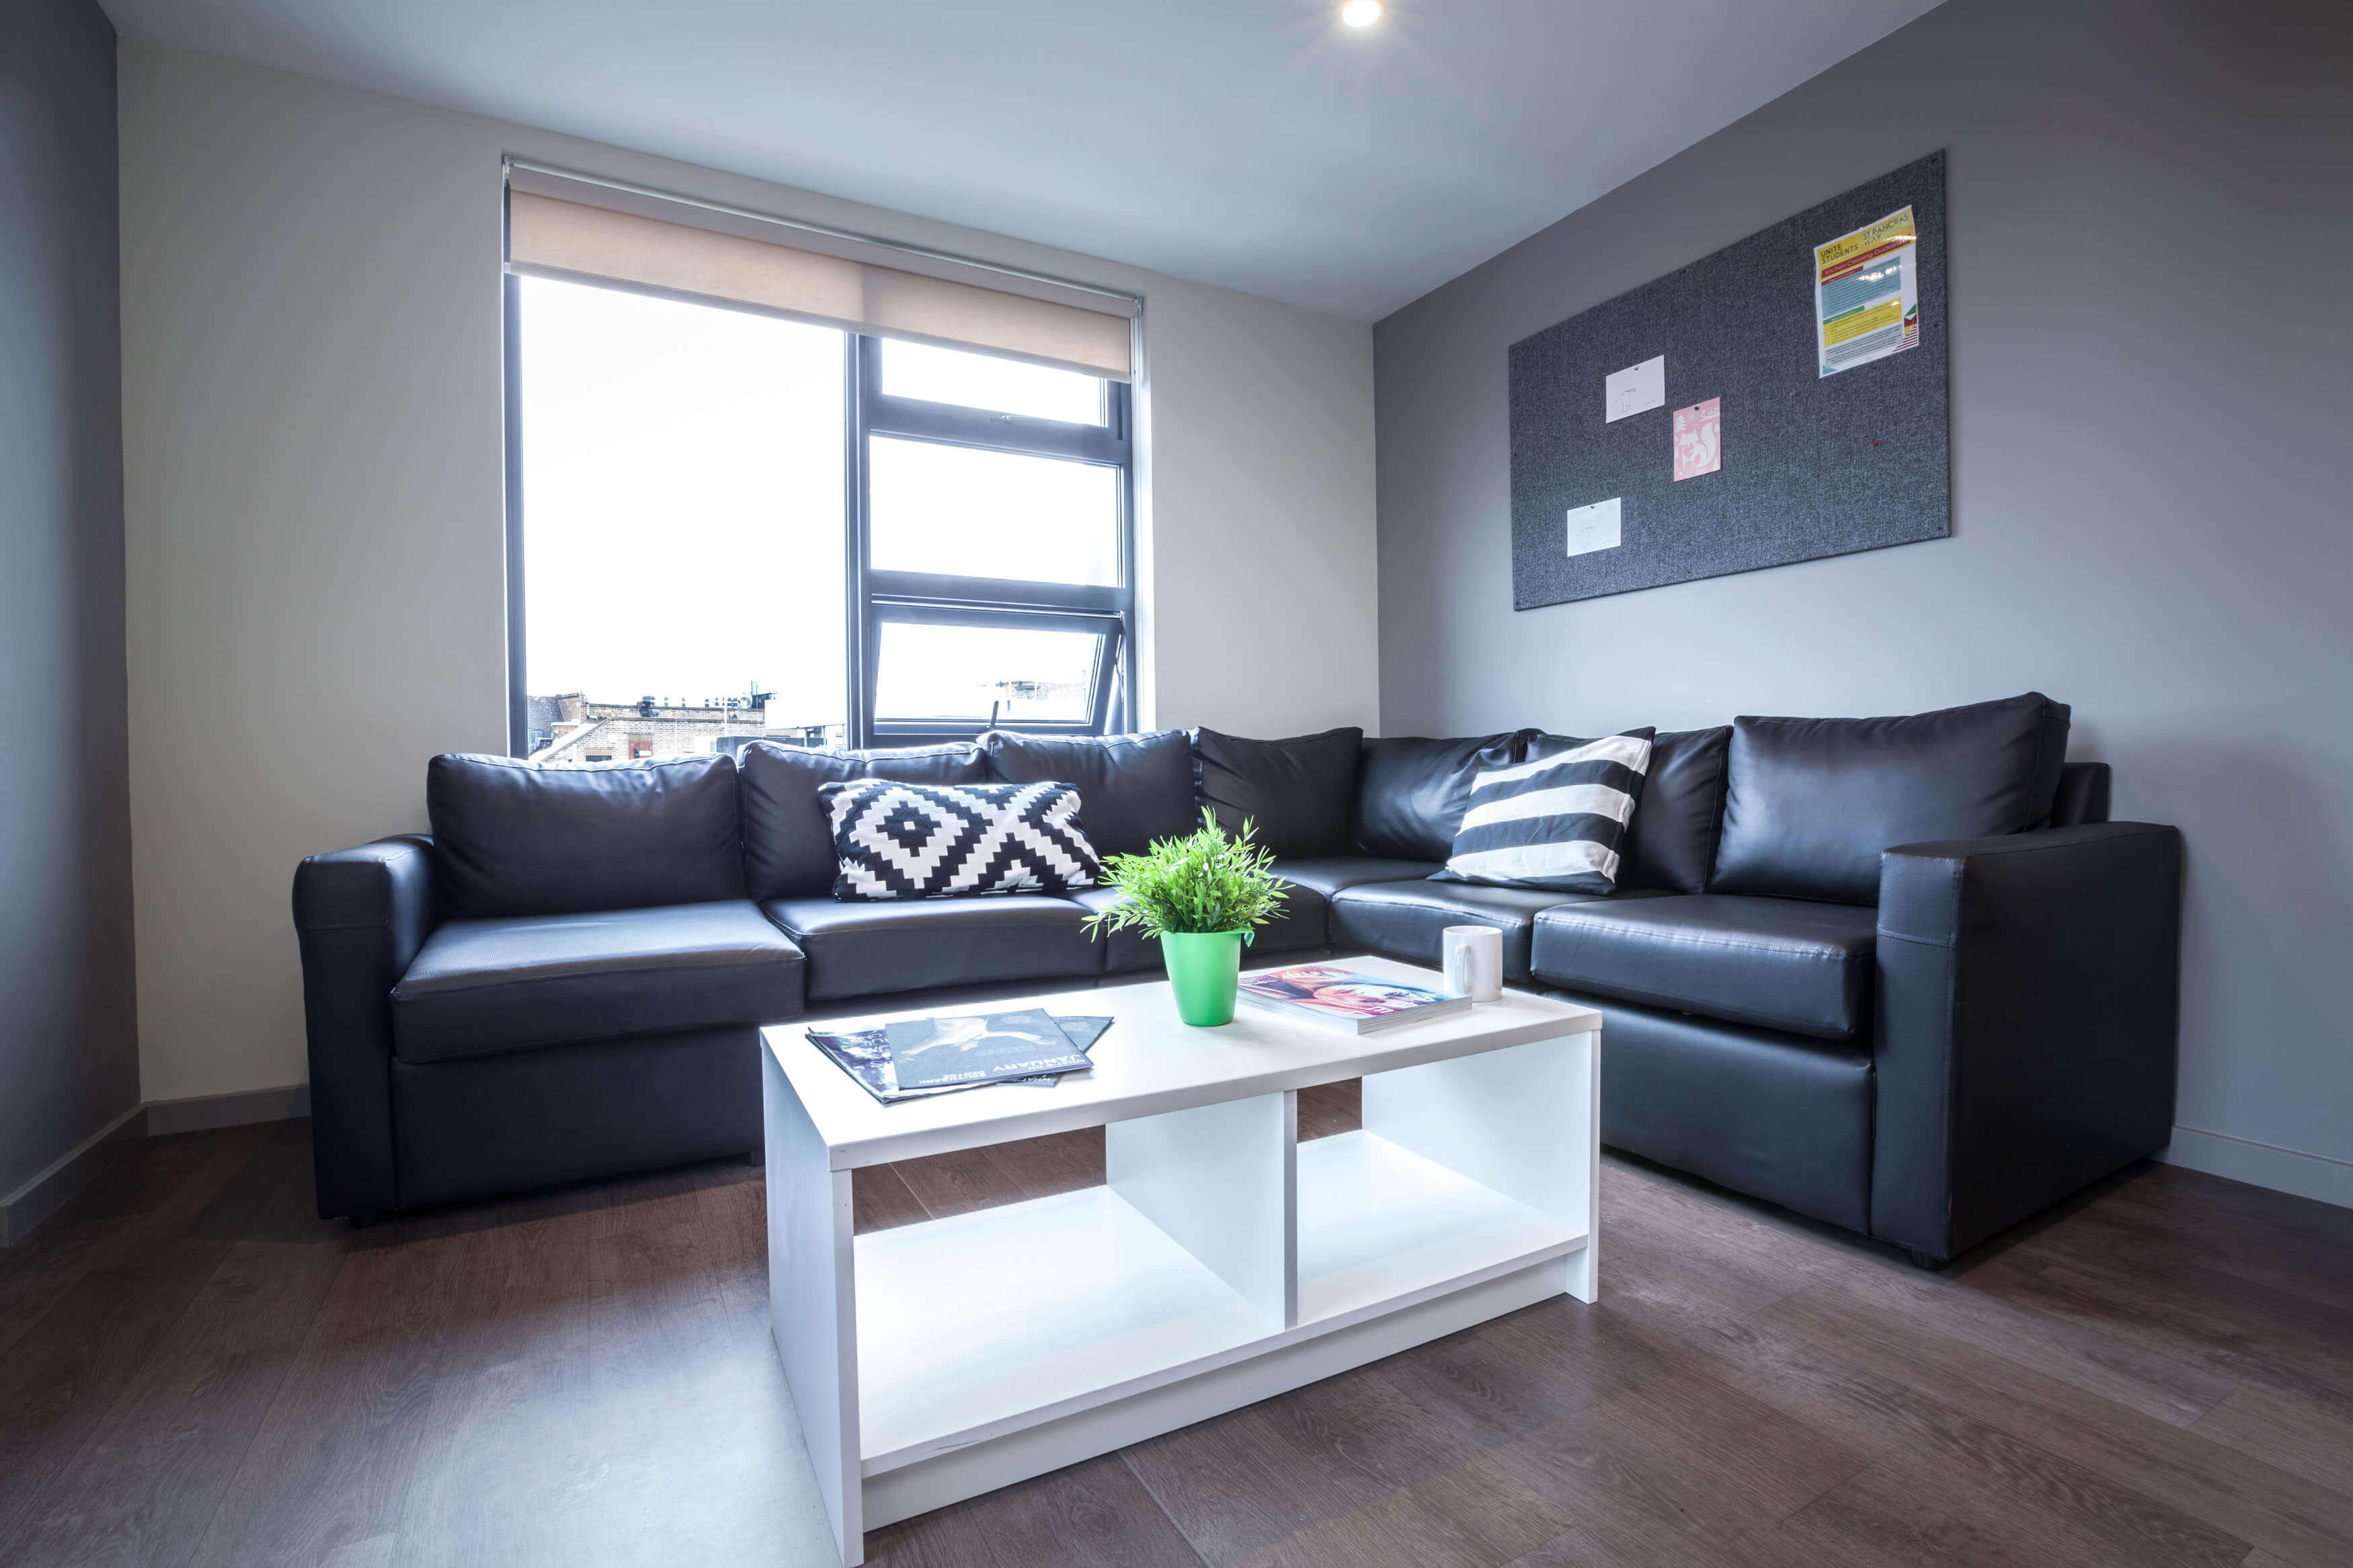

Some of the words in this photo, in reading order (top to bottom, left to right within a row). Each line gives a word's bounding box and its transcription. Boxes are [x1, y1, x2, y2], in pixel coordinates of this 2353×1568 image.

[1872, 214, 1909, 234] PANCRAS
[1864, 233, 1882, 246] WAY
[1821, 243, 1842, 257] UNITE
[1822, 243, 1859, 264] STUDENTS
[1847, 251, 1874, 266] Cleaning
[992, 1055, 1082, 1071] JANUARY
